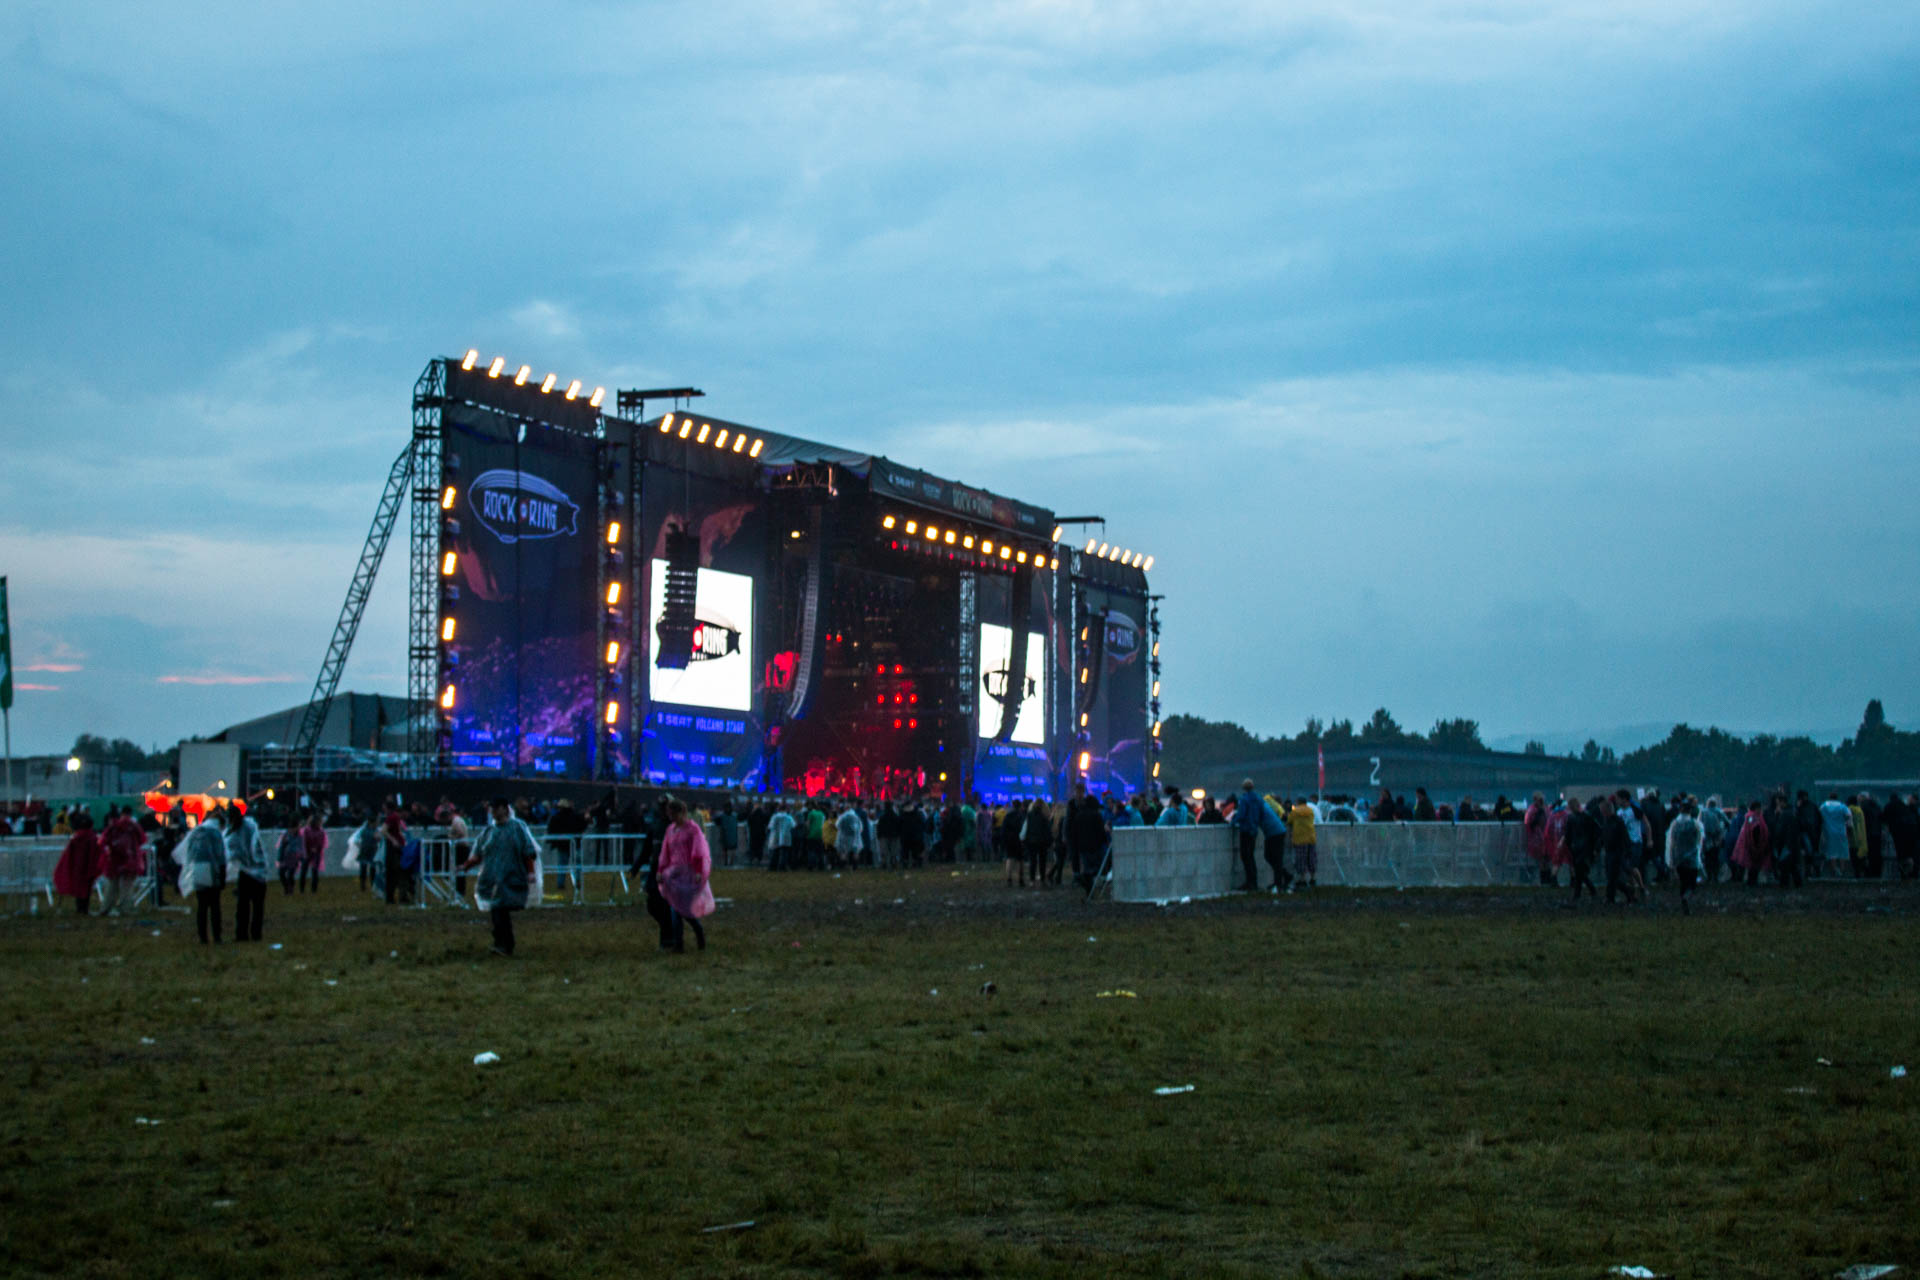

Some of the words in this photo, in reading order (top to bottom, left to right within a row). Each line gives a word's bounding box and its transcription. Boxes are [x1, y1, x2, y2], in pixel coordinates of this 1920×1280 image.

[484, 490, 517, 523] ROCK
[529, 499, 558, 531] RING
[702, 625, 728, 656] RING
[1370, 757, 1380, 785] 2
